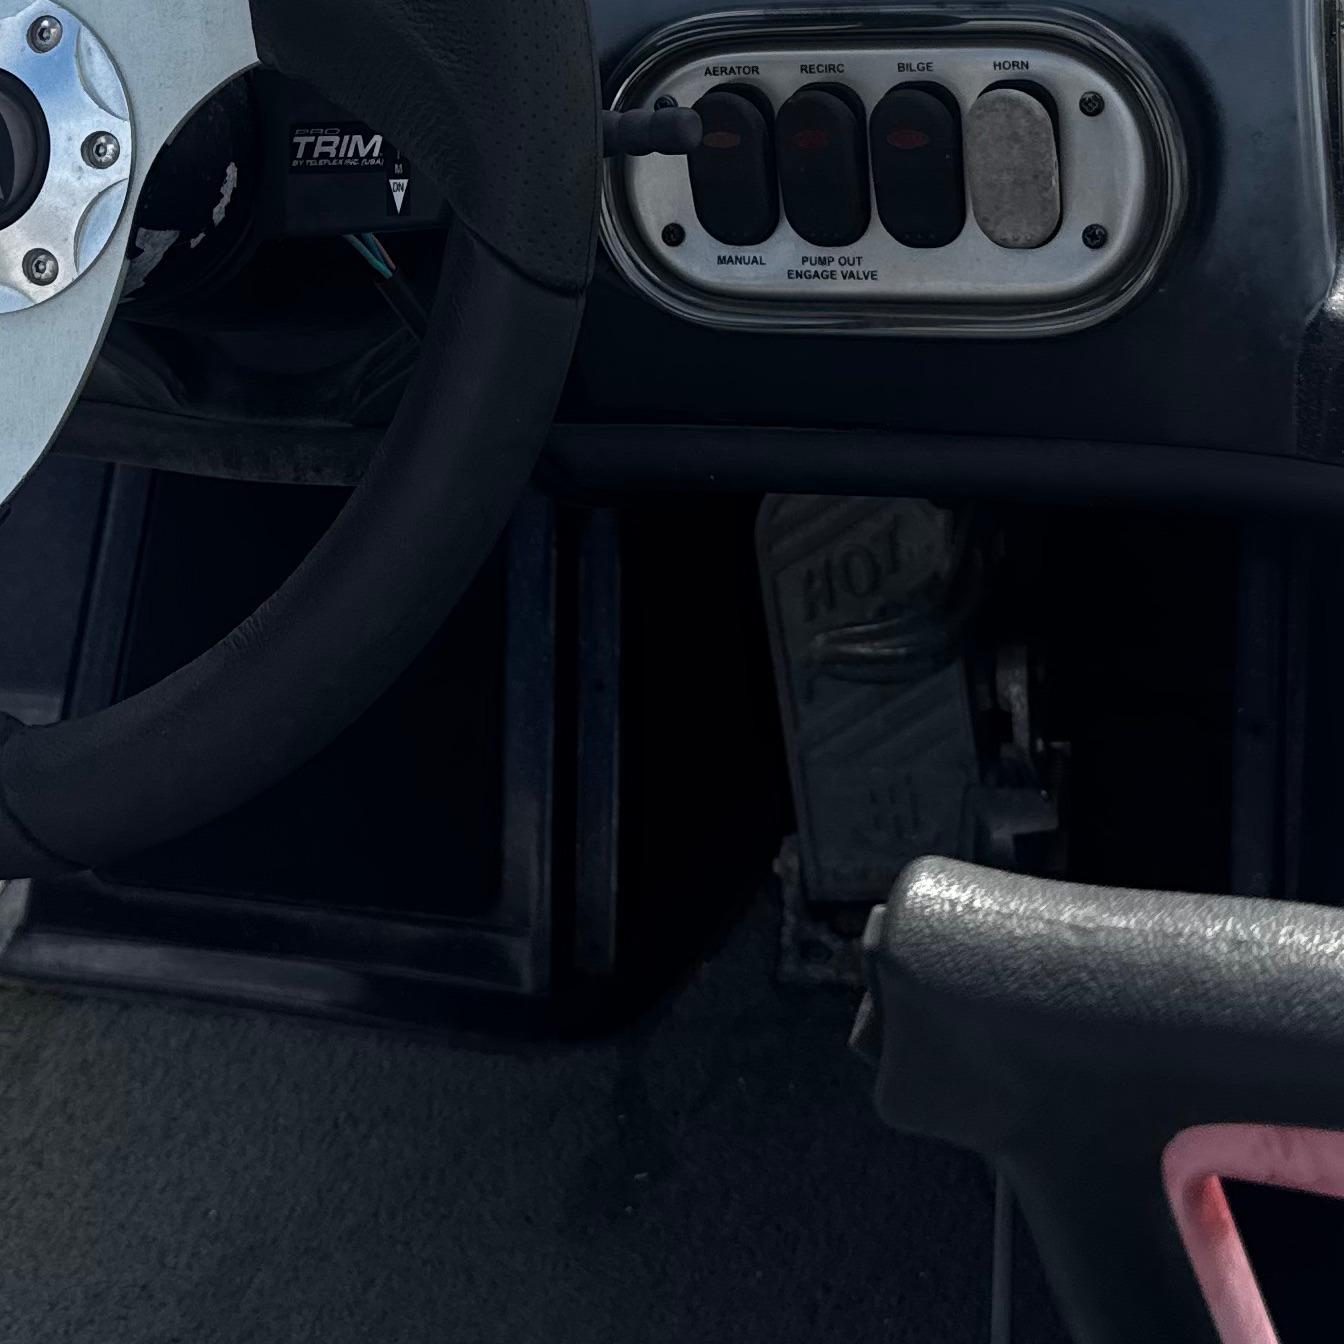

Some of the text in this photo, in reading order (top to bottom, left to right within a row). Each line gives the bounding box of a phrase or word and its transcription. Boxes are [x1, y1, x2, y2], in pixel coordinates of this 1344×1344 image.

[704, 66, 760, 76] AERATOR
[800, 63, 845, 74] RECIRC
[897, 62, 934, 73] BILGE
[993, 60, 1029, 71] HORN
[293, 135, 383, 159] TRIM
[393, 182, 405, 193] DN
[717, 255, 766, 266] MANUAL
[801, 256, 863, 266] PUMP OUT
[787, 269, 878, 280] ENGAGE VALVE
